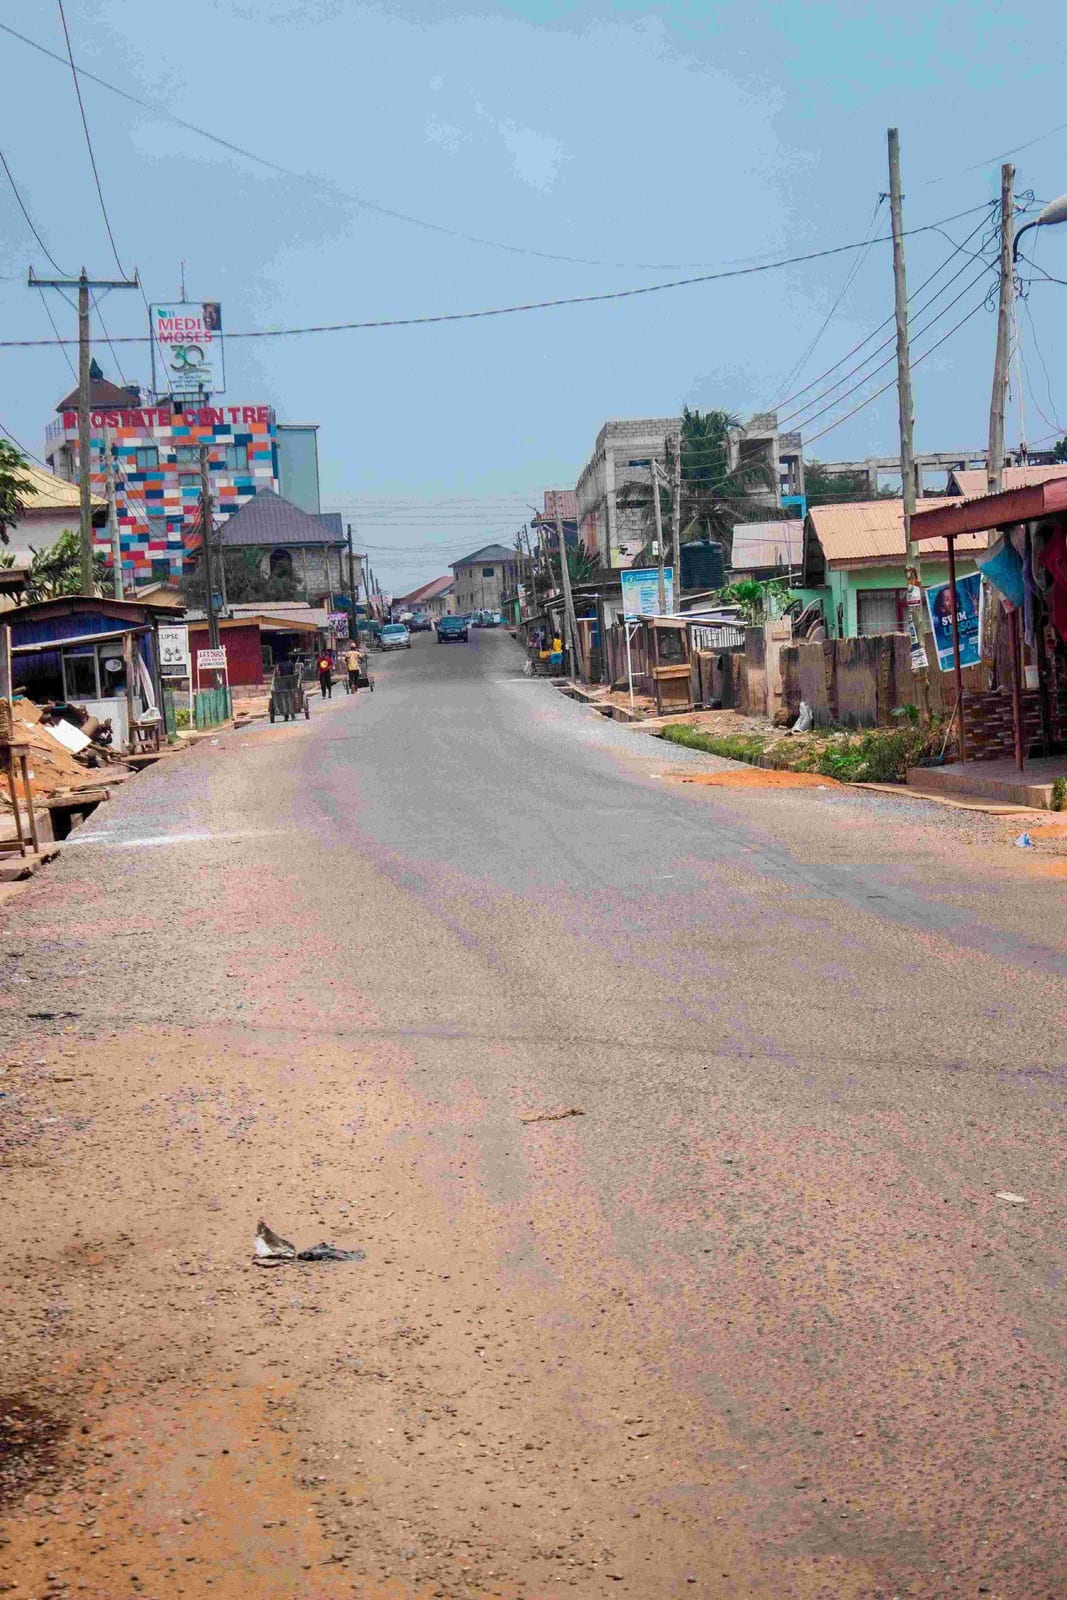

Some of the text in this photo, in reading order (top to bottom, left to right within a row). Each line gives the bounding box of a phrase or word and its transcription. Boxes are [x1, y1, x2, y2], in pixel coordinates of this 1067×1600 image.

[158, 318, 201, 331] MEDI
[158, 331, 212, 343] MOSES
[170, 345, 204, 371] 30
[63, 406, 269, 429] POSTATE CENTRE
